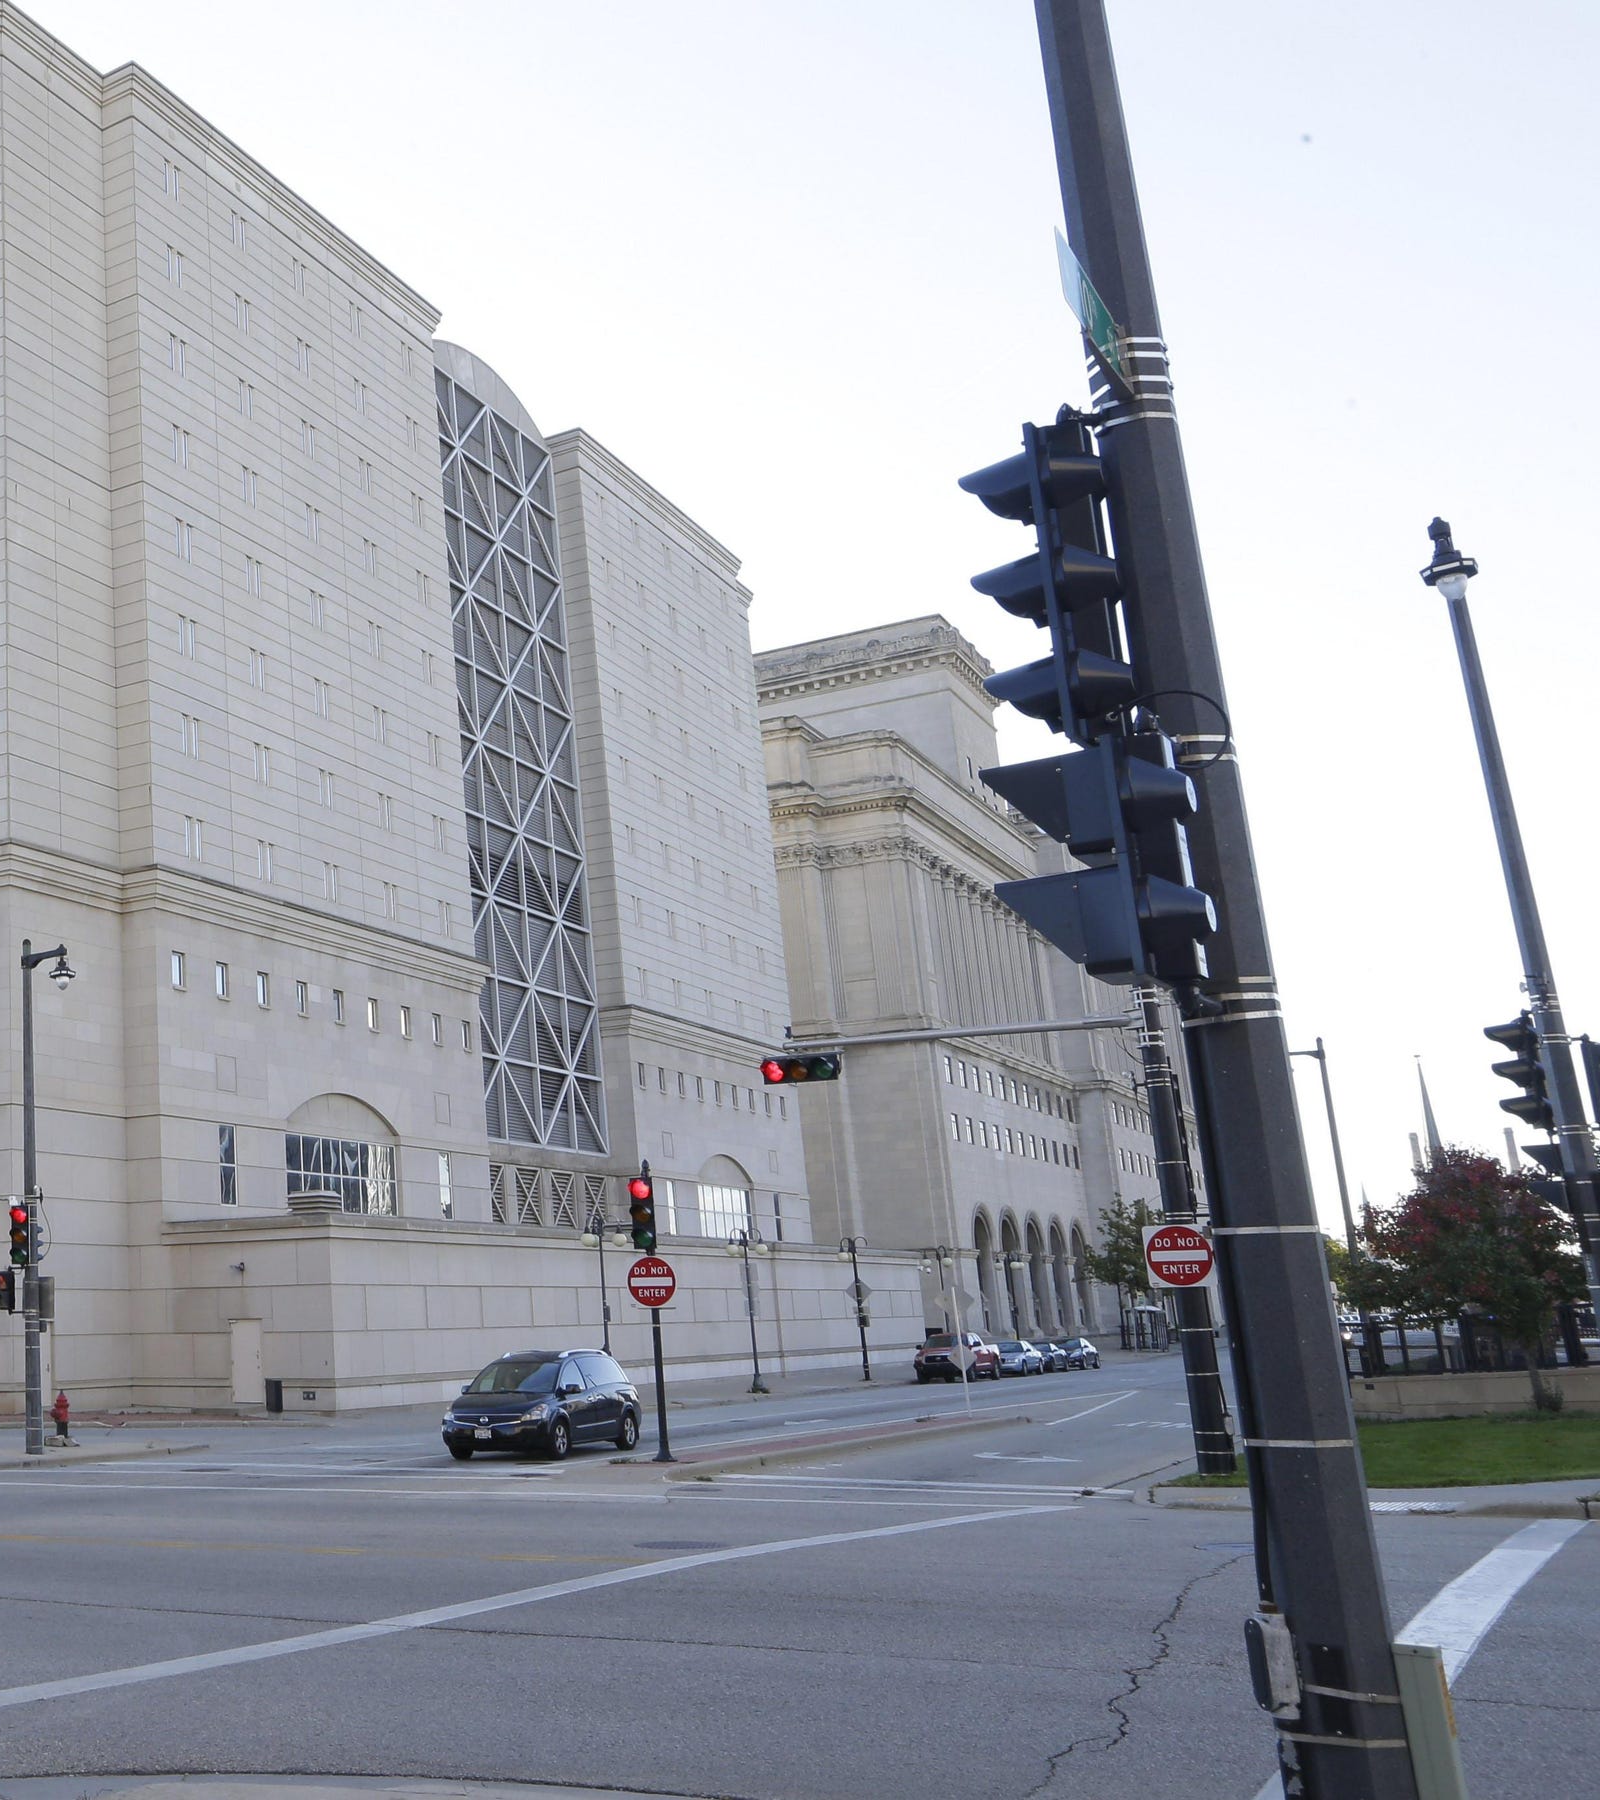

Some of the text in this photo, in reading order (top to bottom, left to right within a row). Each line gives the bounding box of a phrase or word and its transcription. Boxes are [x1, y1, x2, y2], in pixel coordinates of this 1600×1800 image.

[1154, 1236, 1201, 1248] DO NOT
[633, 1266, 668, 1275] DO NOT
[1162, 1263, 1201, 1275] ENTER
[638, 1288, 666, 1298] ENTER
